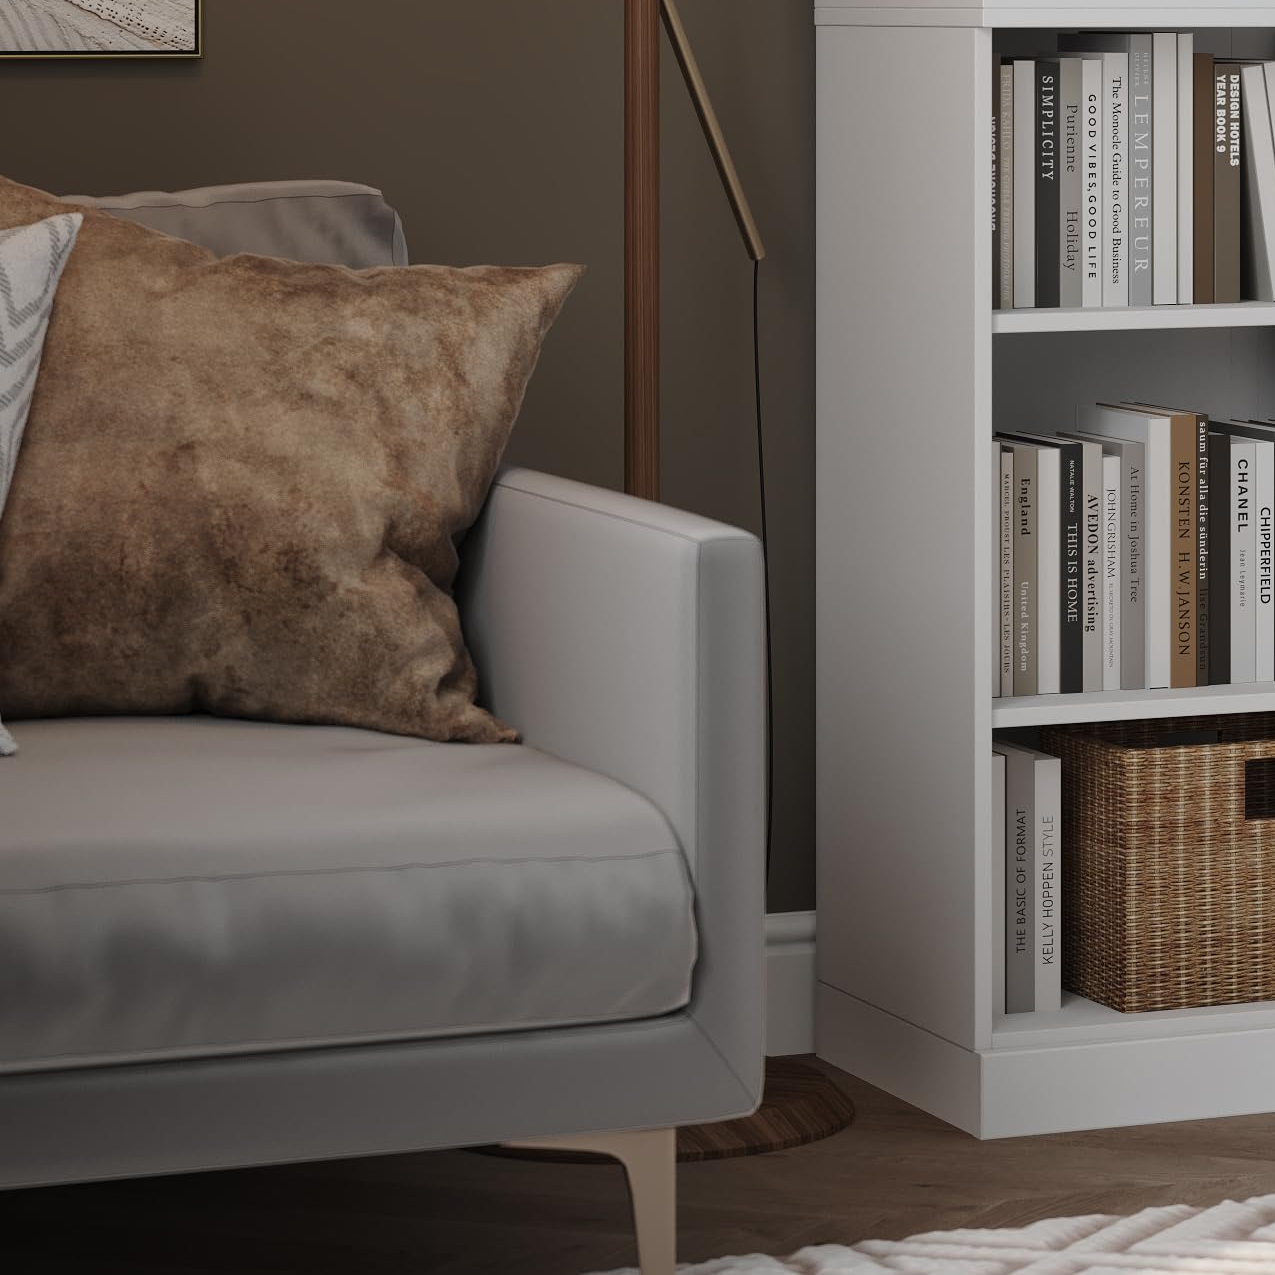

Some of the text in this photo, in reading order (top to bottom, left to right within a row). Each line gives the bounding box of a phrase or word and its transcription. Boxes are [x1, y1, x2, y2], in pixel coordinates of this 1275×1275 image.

[1042, 75, 1053, 181] SIMPLICITY
[1216, 75, 1226, 106] YEAR
[1216, 109, 1226, 142] BOOK
[1230, 75, 1239, 166] DESIGN HOTELS
[1063, 105, 1078, 271] Purienne Holiday
[1112, 77, 1122, 284] The Monocle Guide to Good Business
[1134, 95, 1148, 274] LEMPEREUR
[1018, 478, 1031, 536] England
[1178, 462, 1190, 539] KONSTEN
[1238, 459, 1248, 533] CHANEL
[1068, 523, 1078, 622] THIS IS HOME
[1085, 494, 1099, 632] AVEDON advertising
[1260, 507, 1271, 604] CHIPPERFIELD
[1016, 809, 1026, 953] THE BASIC OF FORMAT
[1042, 815, 1053, 965] KELLY HOPPEN STYLE
